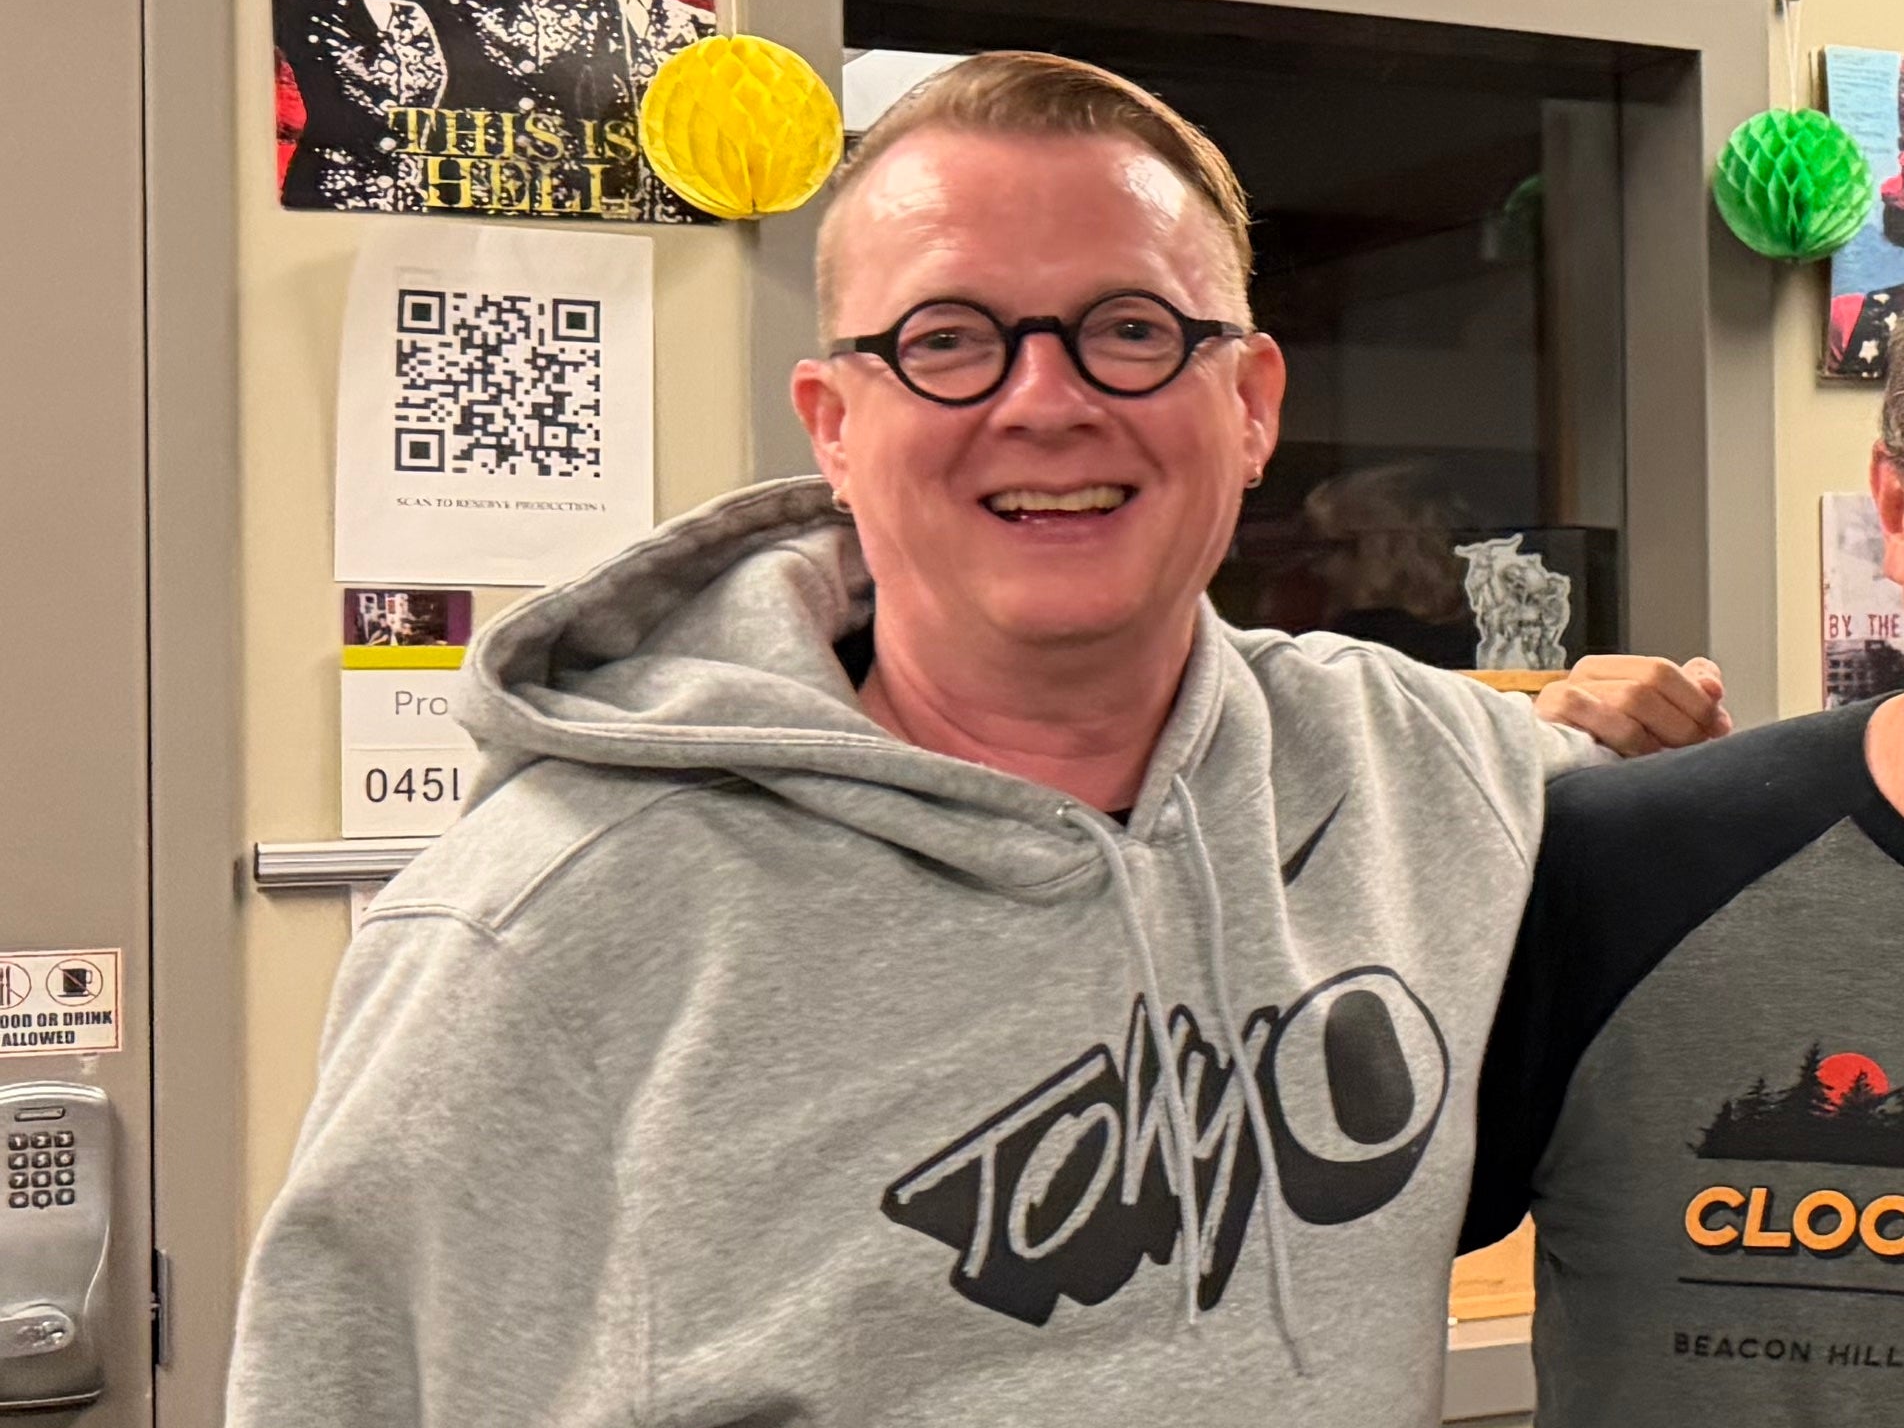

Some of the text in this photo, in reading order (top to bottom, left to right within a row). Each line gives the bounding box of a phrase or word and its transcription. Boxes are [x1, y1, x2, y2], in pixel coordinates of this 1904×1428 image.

[387, 106, 641, 161] THIS IS
[396, 497, 433, 508] SCAN
[436, 498, 453, 508] TO
[1829, 614, 1901, 638] BY THE
[394, 690, 448, 716] Pro
[0, 1010, 113, 1029] OOD OR DRINK
[1, 1030, 76, 1047] ALLOWED
[881, 964, 1450, 1326] TOKYO
[1673, 1330, 1811, 1364] BEACON
[1826, 1341, 1904, 1369] HILL
